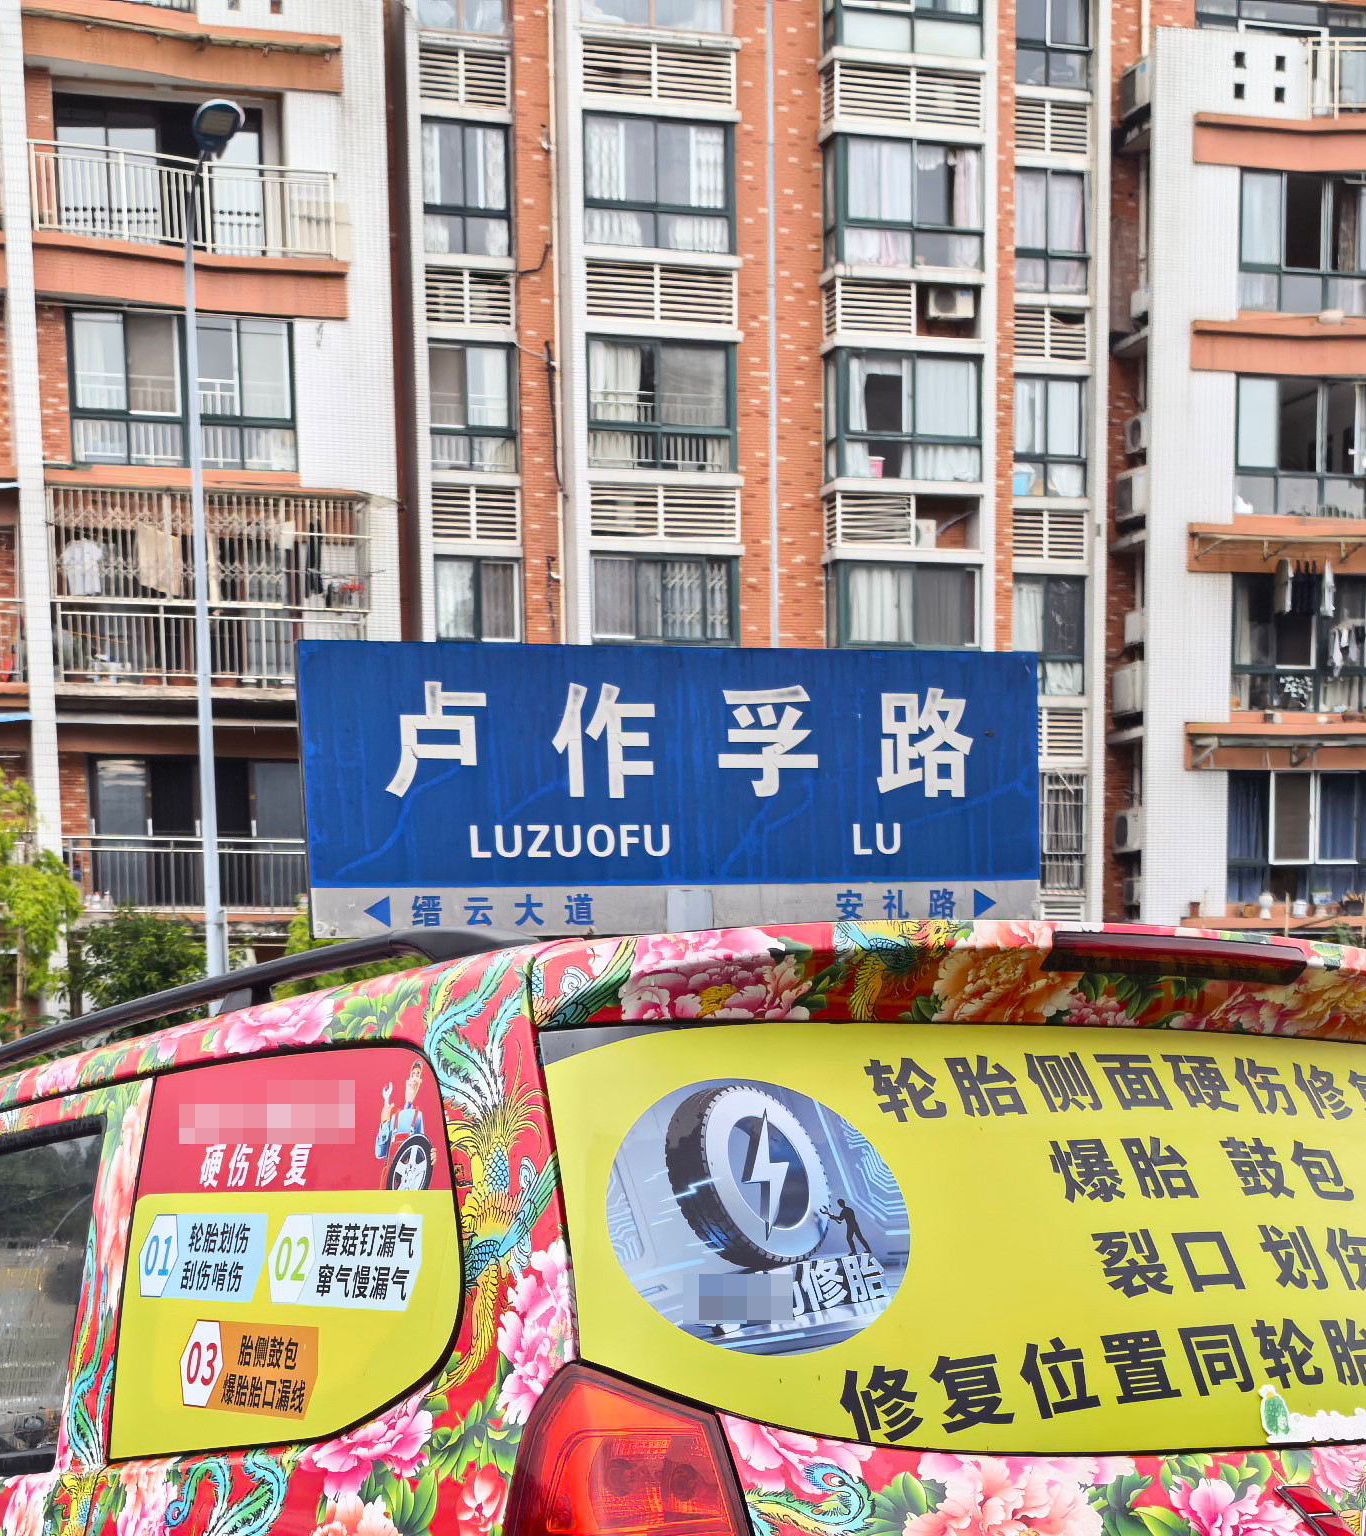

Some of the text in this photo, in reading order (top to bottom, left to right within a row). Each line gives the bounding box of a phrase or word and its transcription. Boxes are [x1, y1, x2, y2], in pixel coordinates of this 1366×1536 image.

[386, 681, 973, 799] 卢作孚路
[470, 823, 901, 859] LUZUOFU LU
[412, 895, 595, 927] 缙云大道
[836, 890, 956, 920] 安礼路
[199, 1143, 313, 1188] 硬伤修复
[1048, 1136, 1355, 1203] 爆胎 鼓包
[144, 1235, 173, 1276] 01
[188, 1222, 251, 1254] 轮胎划伤
[274, 1236, 310, 1281] 02
[322, 1223, 418, 1259] 蘑菇钉漏气
[180, 1260, 244, 1292] 刮伤啃伤
[315, 1263, 410, 1301] 窜气慢漏气
[1091, 1228, 1246, 1298] 裂口
[186, 1341, 218, 1386] 03
[220, 1371, 307, 1414] 爆胎胎口漏线
